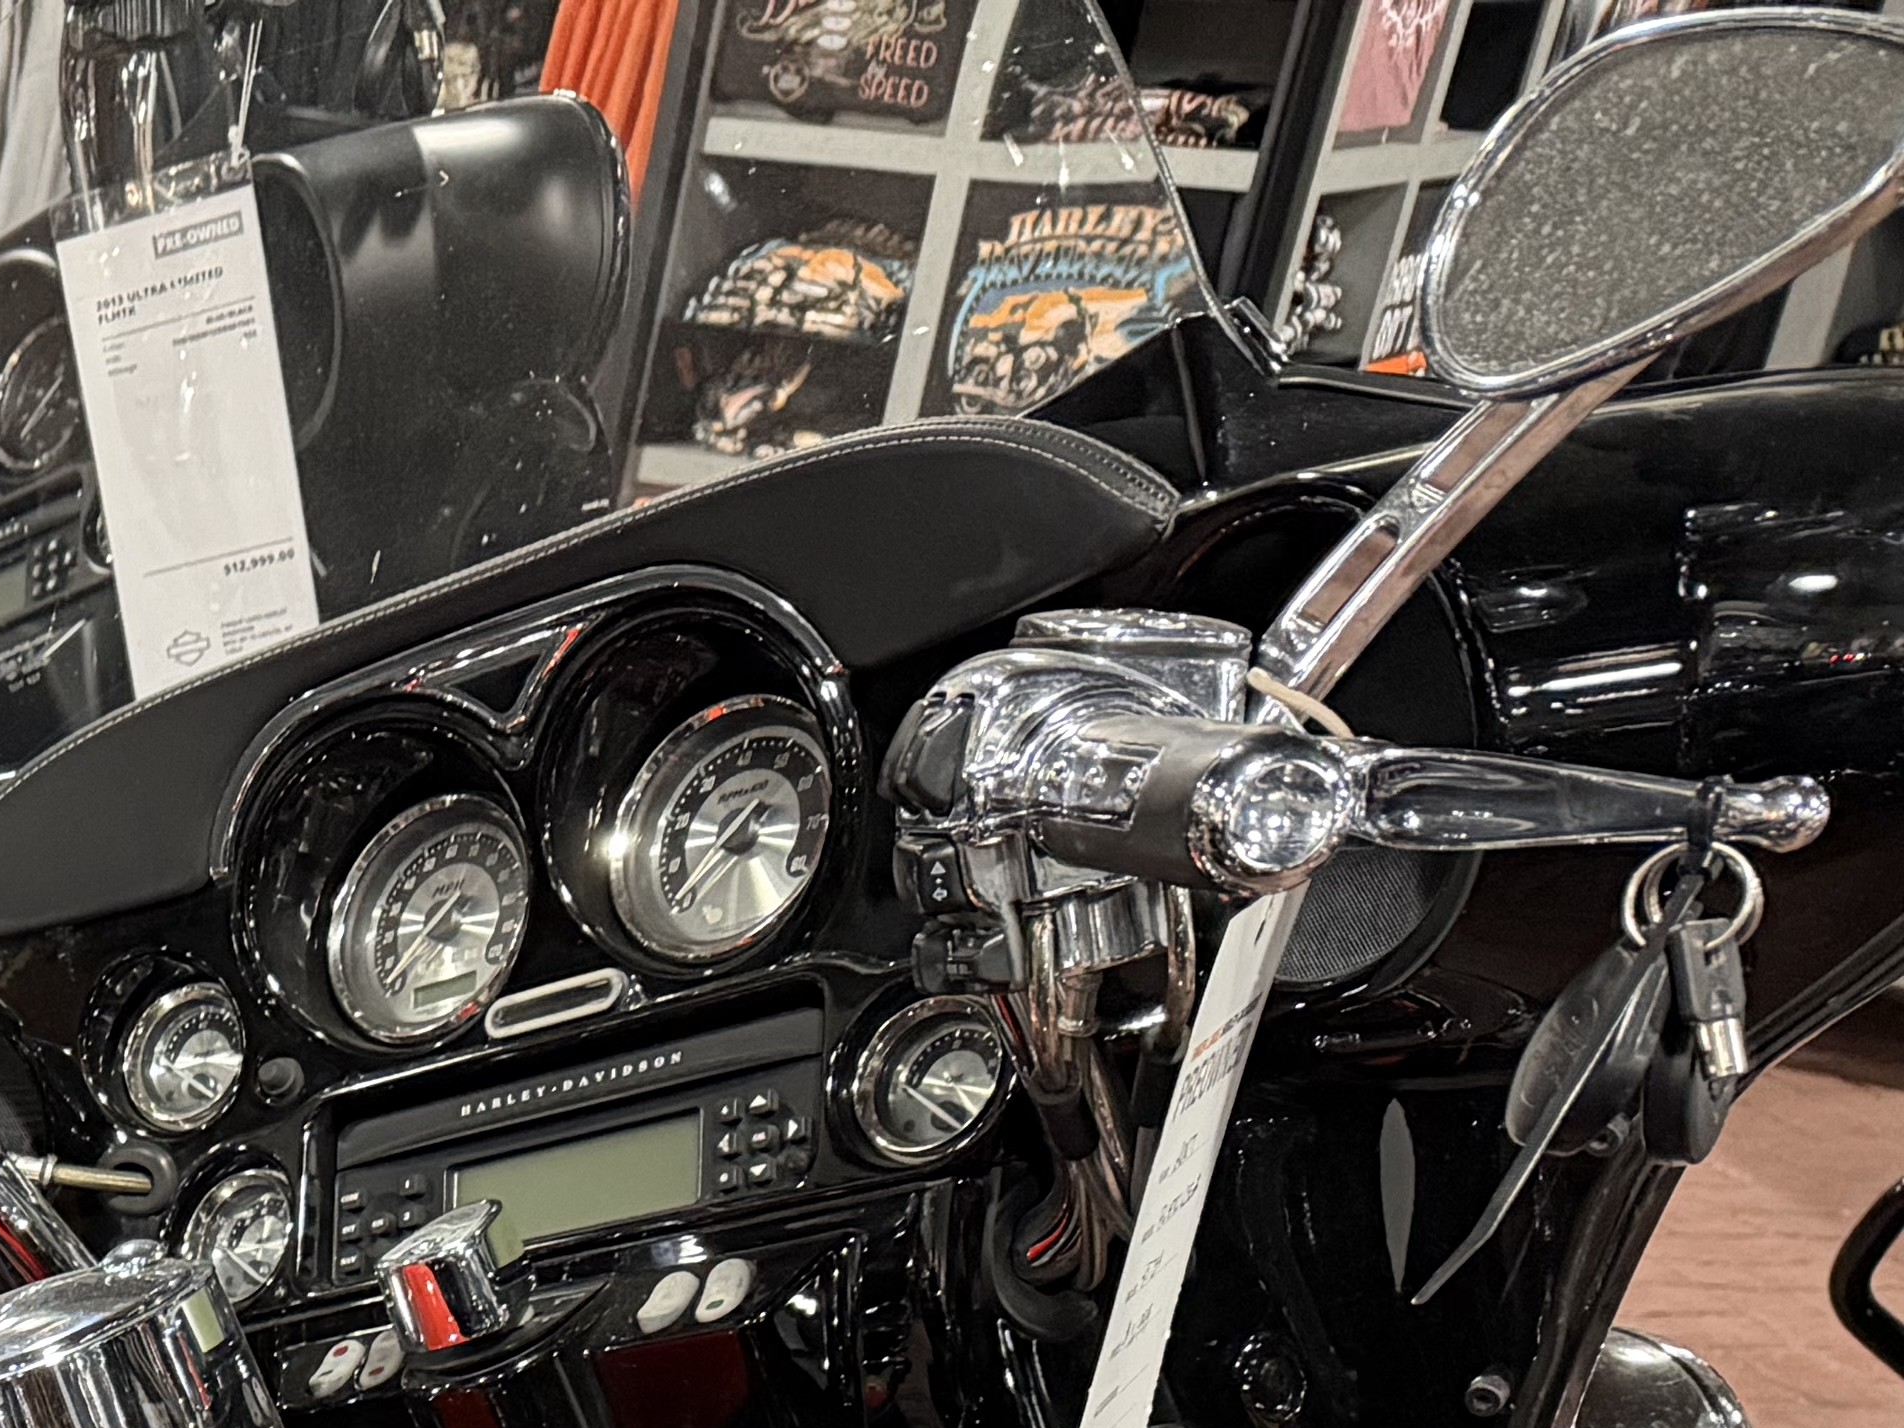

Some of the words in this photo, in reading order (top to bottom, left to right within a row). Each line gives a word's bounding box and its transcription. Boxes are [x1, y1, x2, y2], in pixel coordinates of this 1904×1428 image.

[858, 72, 929, 109] SPEED
[155, 217, 241, 256] PRE-OWNED
[126, 281, 168, 304] ULTRA
[223, 547, 296, 577] $12,999.00
[431, 877, 466, 899] MPH
[460, 1050, 683, 1117] HARLEY-DAVIDSON
